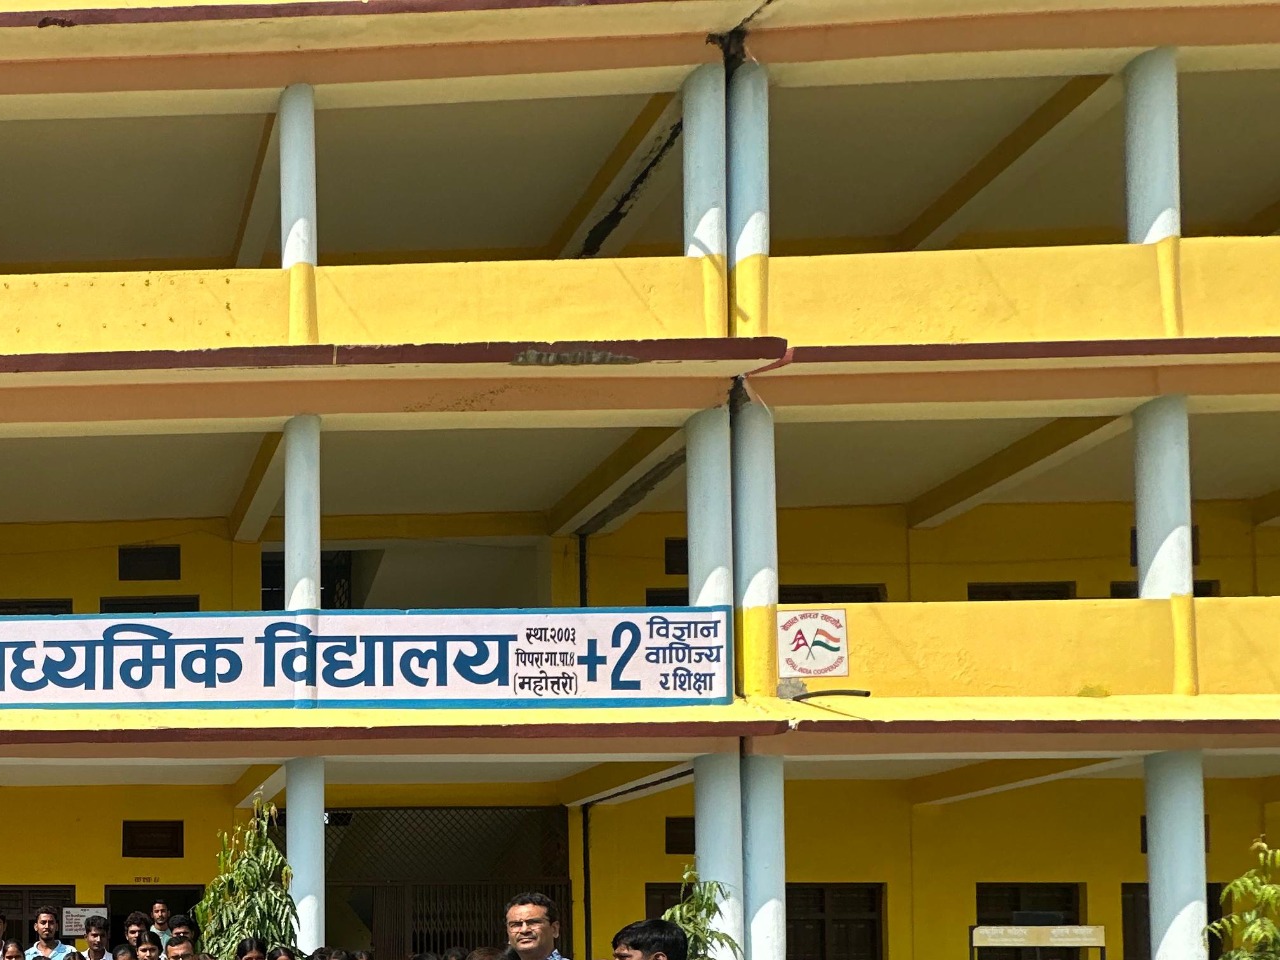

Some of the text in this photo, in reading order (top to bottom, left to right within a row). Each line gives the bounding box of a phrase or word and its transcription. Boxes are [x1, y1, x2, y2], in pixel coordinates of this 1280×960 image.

[646, 616, 721, 642] विज्ञान
[255, 621, 519, 692] विद्यालय
[515, 649, 544, 669] पिपरा
[645, 642, 724, 664] वाणिज्य
[785, 657, 798, 671] NEPAL
[799, 666, 812, 675] INDIA
[513, 670, 578, 697] (महोत्तरी)
[672, 666, 716, 695] शिक्षा
